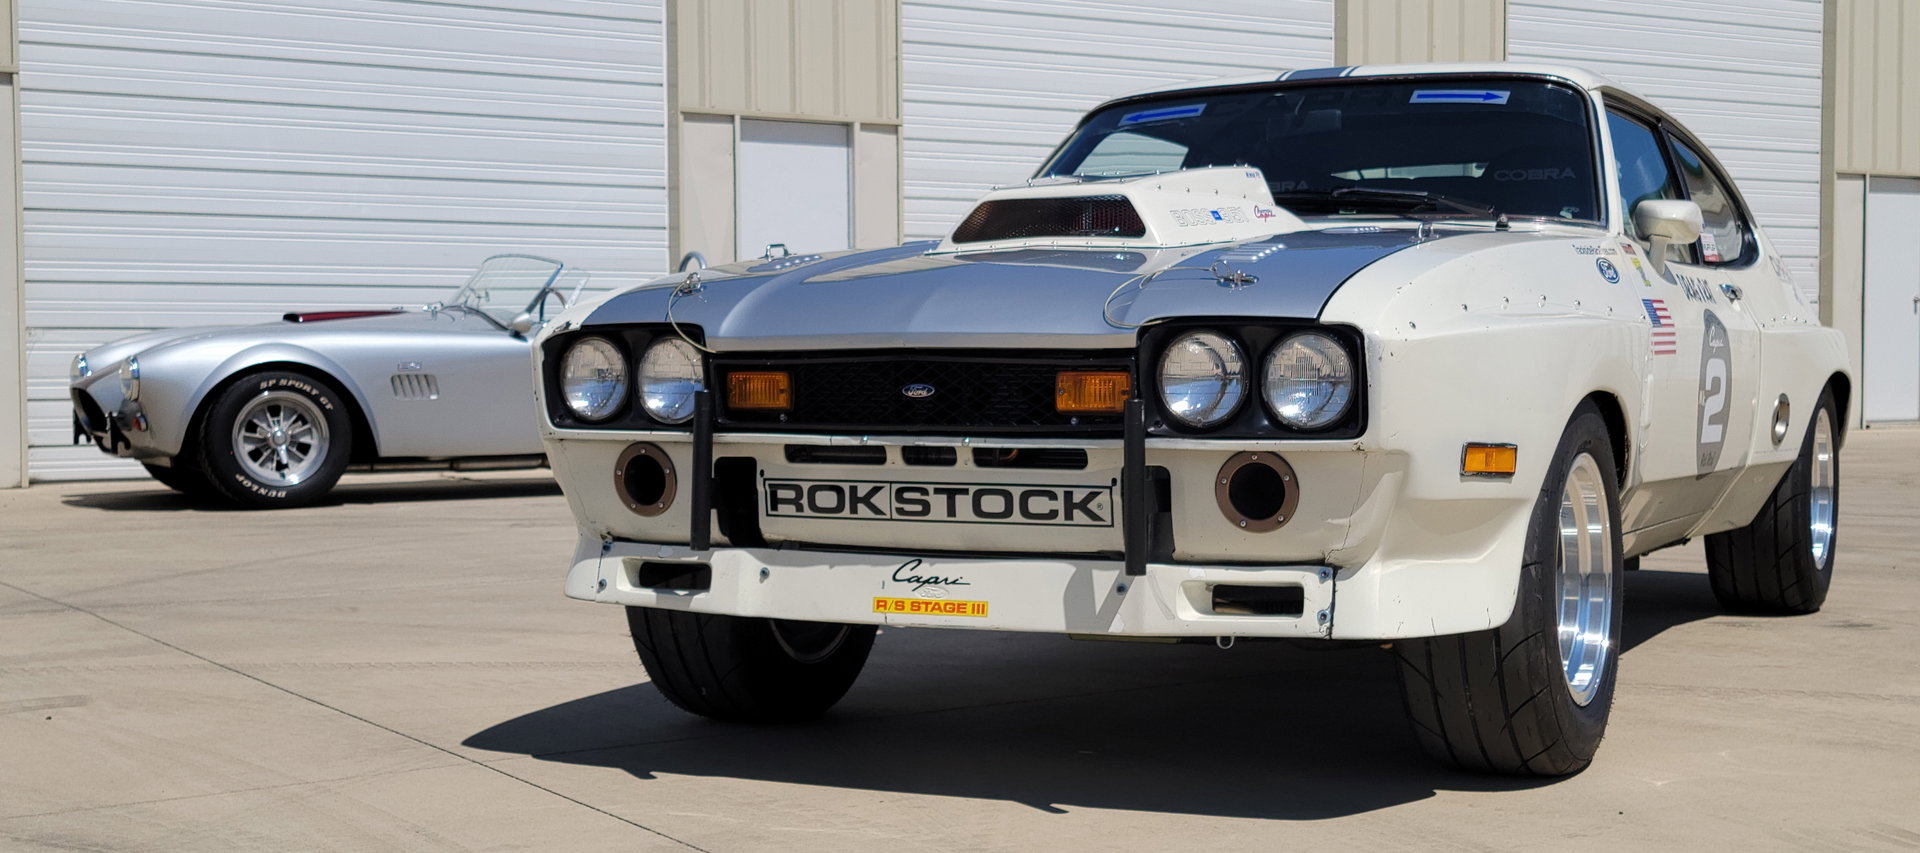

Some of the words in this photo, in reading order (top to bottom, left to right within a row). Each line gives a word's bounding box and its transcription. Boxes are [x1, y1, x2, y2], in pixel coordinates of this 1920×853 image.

[1493, 168, 1576, 182] COBRA
[1268, 180, 1309, 192] BRA
[260, 378, 277, 390] SP
[280, 378, 320, 397] SPORT
[904, 384, 931, 398] Ford
[1700, 358, 1727, 444] 2
[234, 473, 288, 499] DUNLOP
[891, 558, 971, 592] Capri
[875, 599, 906, 612] R/S
[909, 601, 968, 614] STAGE
[971, 603, 986, 615] III
